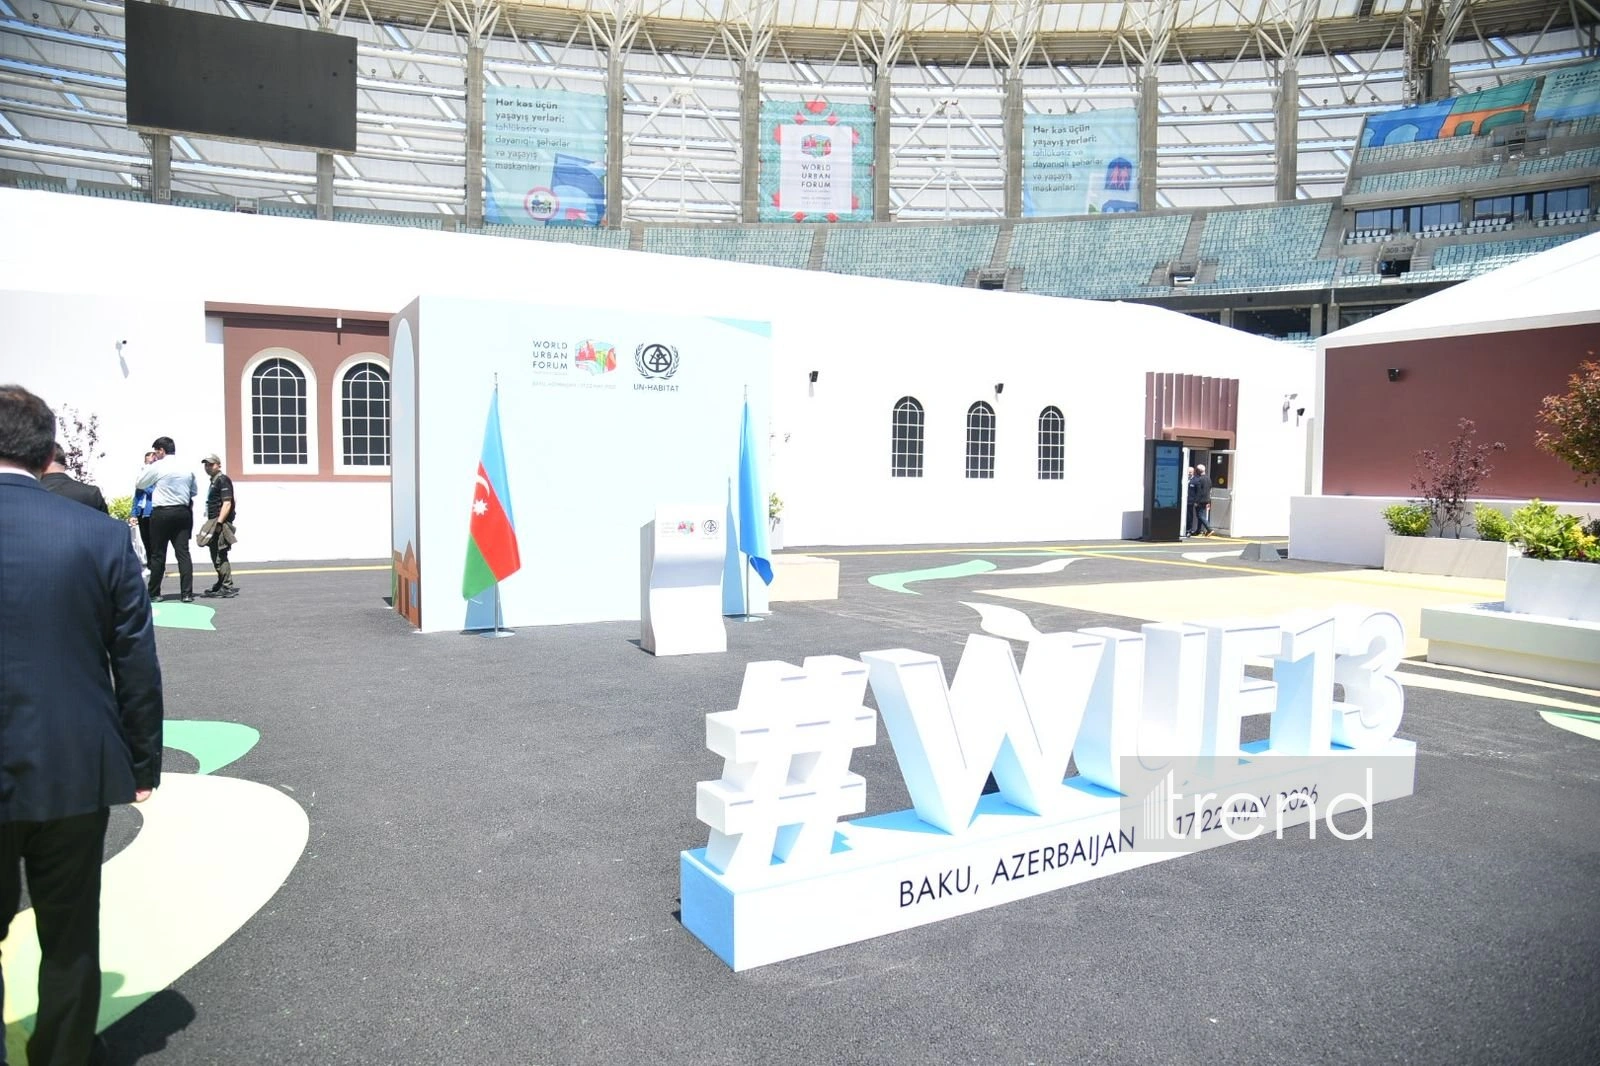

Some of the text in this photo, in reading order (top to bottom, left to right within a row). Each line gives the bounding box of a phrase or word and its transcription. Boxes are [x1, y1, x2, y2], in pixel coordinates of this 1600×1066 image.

[495, 98, 558, 111] Hər kəs üçün
[495, 112, 565, 123] yaşayış yerləri:
[1051, 126, 1067, 134] kəs
[1069, 124, 1091, 135] üçün
[1032, 134, 1097, 147] yaşayış yerləri:
[532, 340, 568, 349] WORLD
[532, 351, 568, 359] URBAN
[532, 361, 568, 369] FORUM
[633, 383, 679, 392] UN-HABITAT
[696, 609, 1405, 875] #WUF13
[899, 866, 980, 908] BAKU,
[991, 825, 1136, 887] AZERBAIJAN
